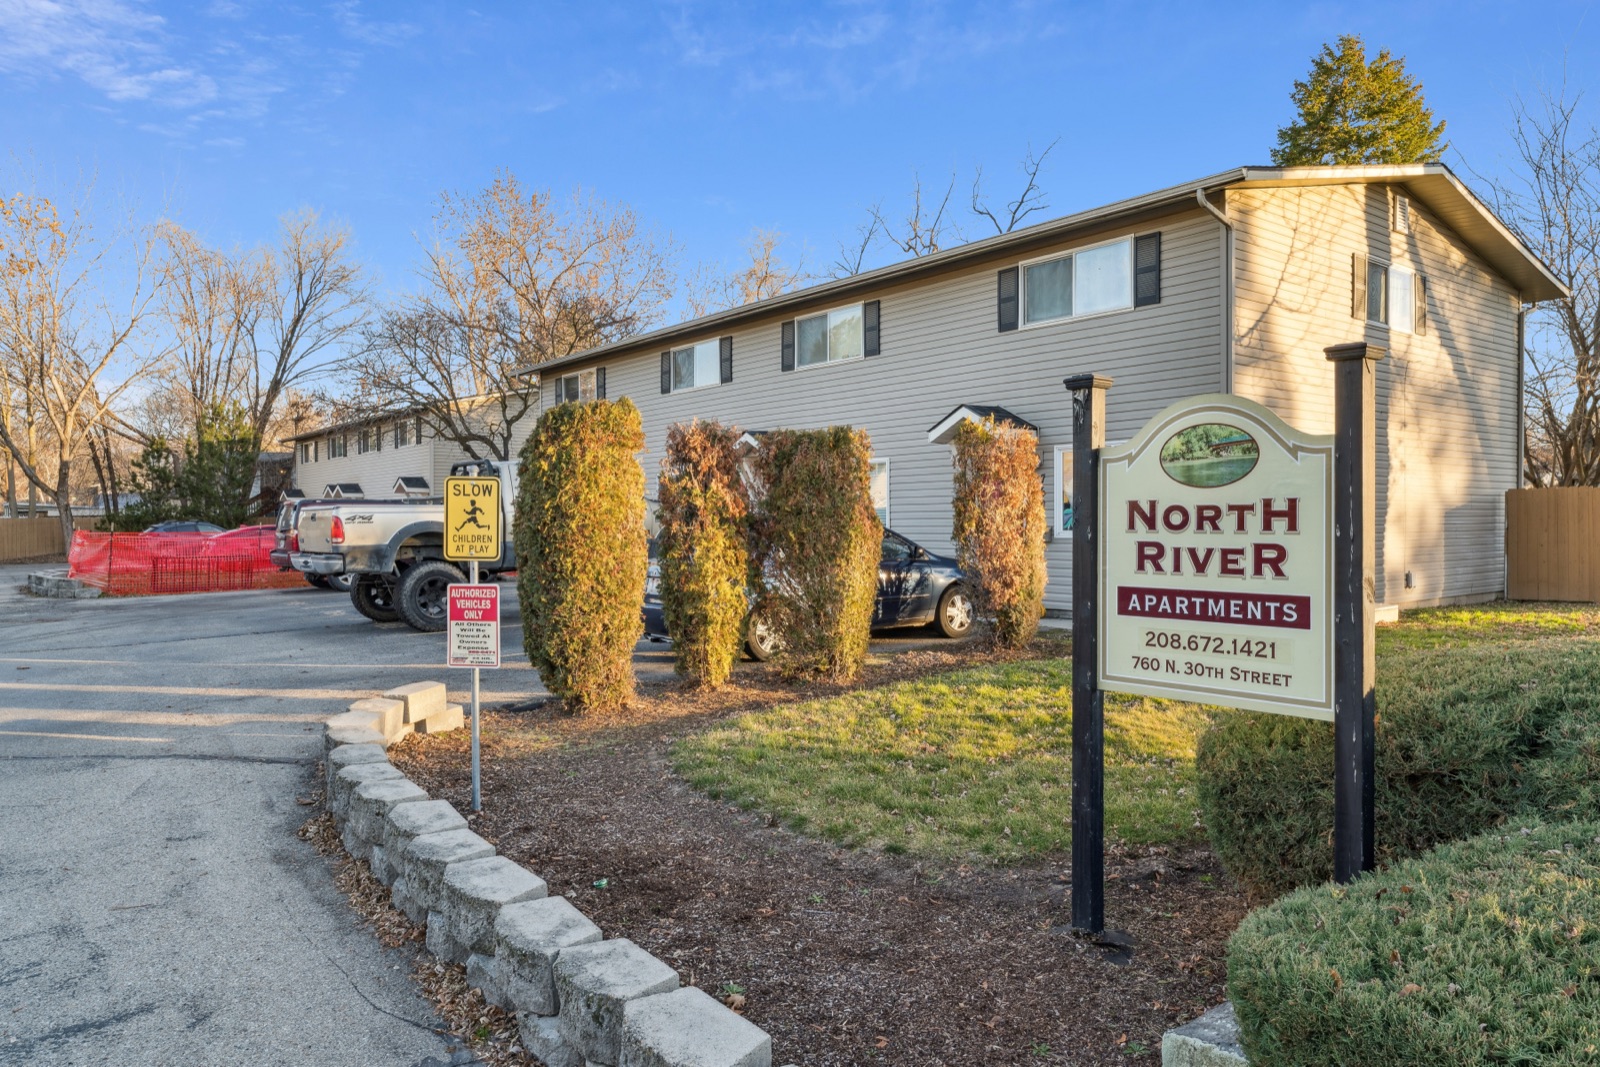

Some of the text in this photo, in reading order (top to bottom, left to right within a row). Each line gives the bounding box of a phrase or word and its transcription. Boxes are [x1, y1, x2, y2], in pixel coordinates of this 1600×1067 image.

[452, 483, 493, 497] SLOW
[1125, 497, 1301, 535] NORTH
[452, 534, 493, 543] CHILDREN
[455, 544, 489, 553] AT PLAY
[1134, 540, 1289, 580] RIVER
[451, 588, 496, 598] AUTHORIZED
[456, 599, 491, 609] VEHICLES
[1128, 594, 1298, 623] APARTMENTS
[463, 610, 483, 619] ONLY
[1145, 631, 1276, 659] 208.672.1421
[1131, 656, 1292, 687] 760 N. 30TH STREET
